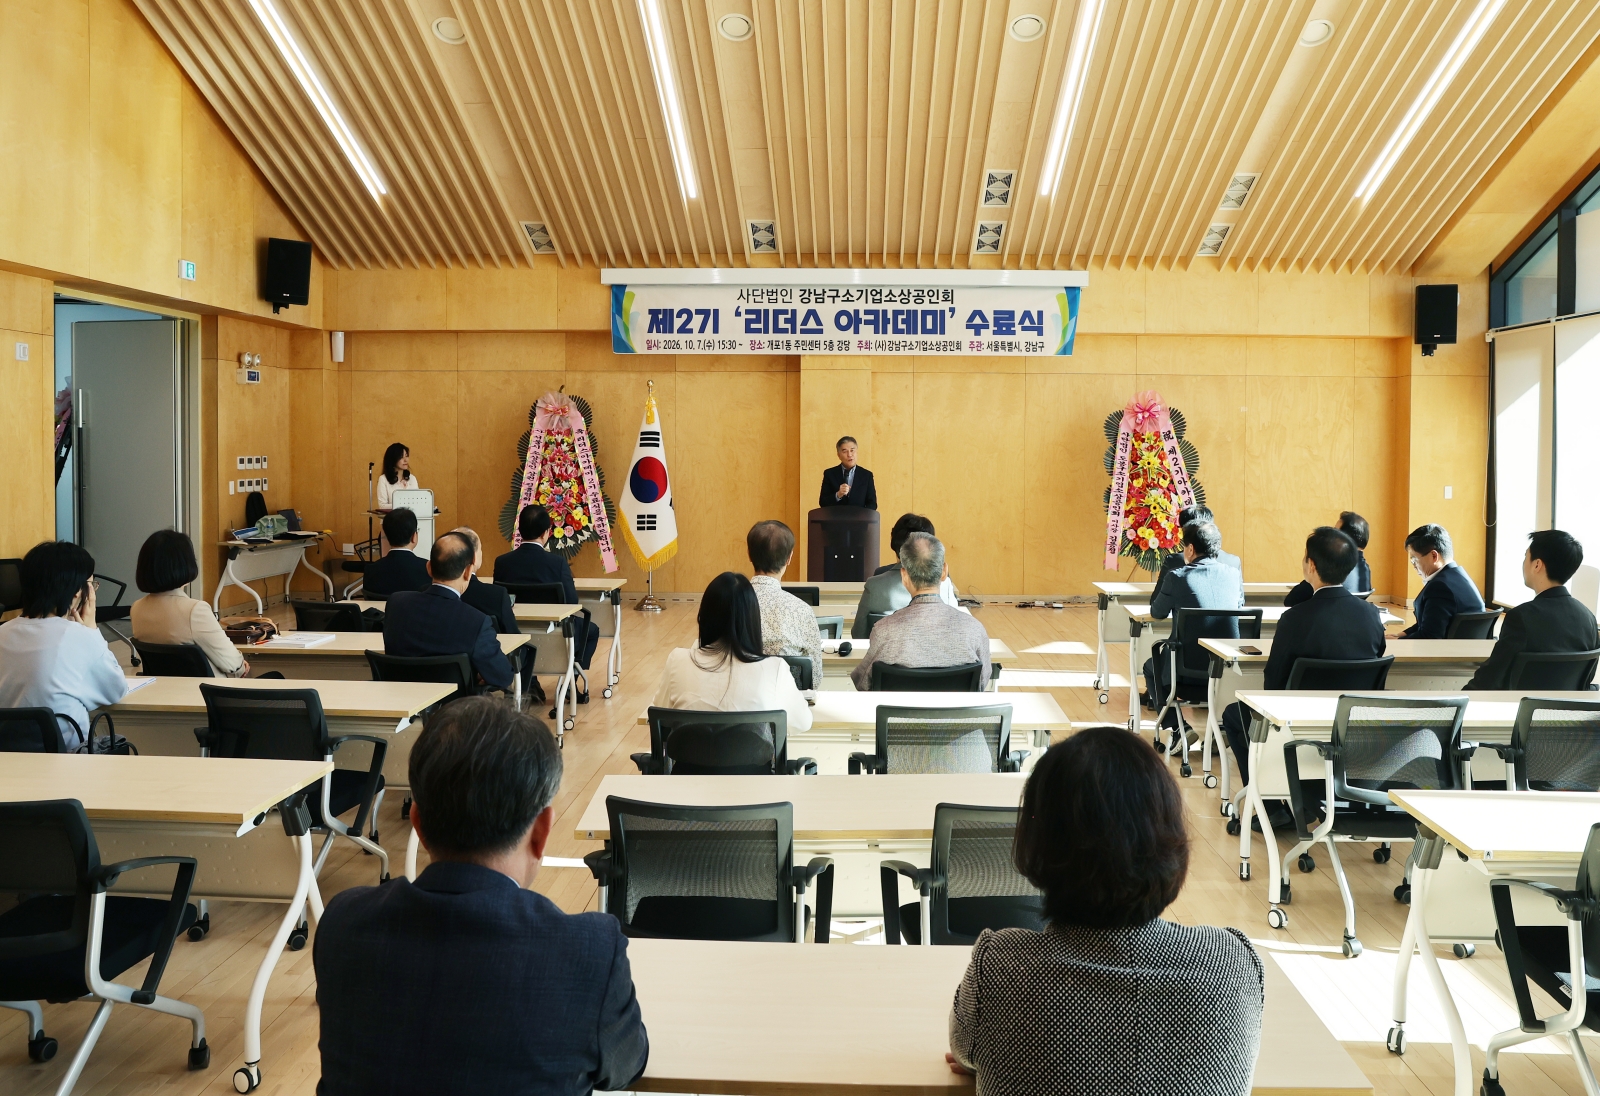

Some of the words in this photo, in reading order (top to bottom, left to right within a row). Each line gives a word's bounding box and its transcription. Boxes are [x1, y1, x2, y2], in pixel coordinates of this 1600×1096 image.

[737, 288, 793, 304] 사단법인
[799, 288, 954, 305] 강남구소기업소상공인회
[647, 308, 719, 334] 제2기
[965, 309, 1044, 336] 수료식
[645, 339, 662, 351] 일시:
[663, 340, 683, 350] 2026.
[684, 340, 696, 350] 10.
[717, 340, 737, 350] 15:30
[749, 339, 765, 351] 장소:
[767, 339, 792, 351] 개포1동
[793, 340, 822, 351] 주민센터
[823, 340, 835, 351] 5층
[836, 340, 851, 351] 강당
[857, 340, 873, 351] 주최:
[968, 340, 985, 352] 주관:
[986, 340, 1023, 352] 서울특별시,
[1024, 341, 1045, 352] 강남구
